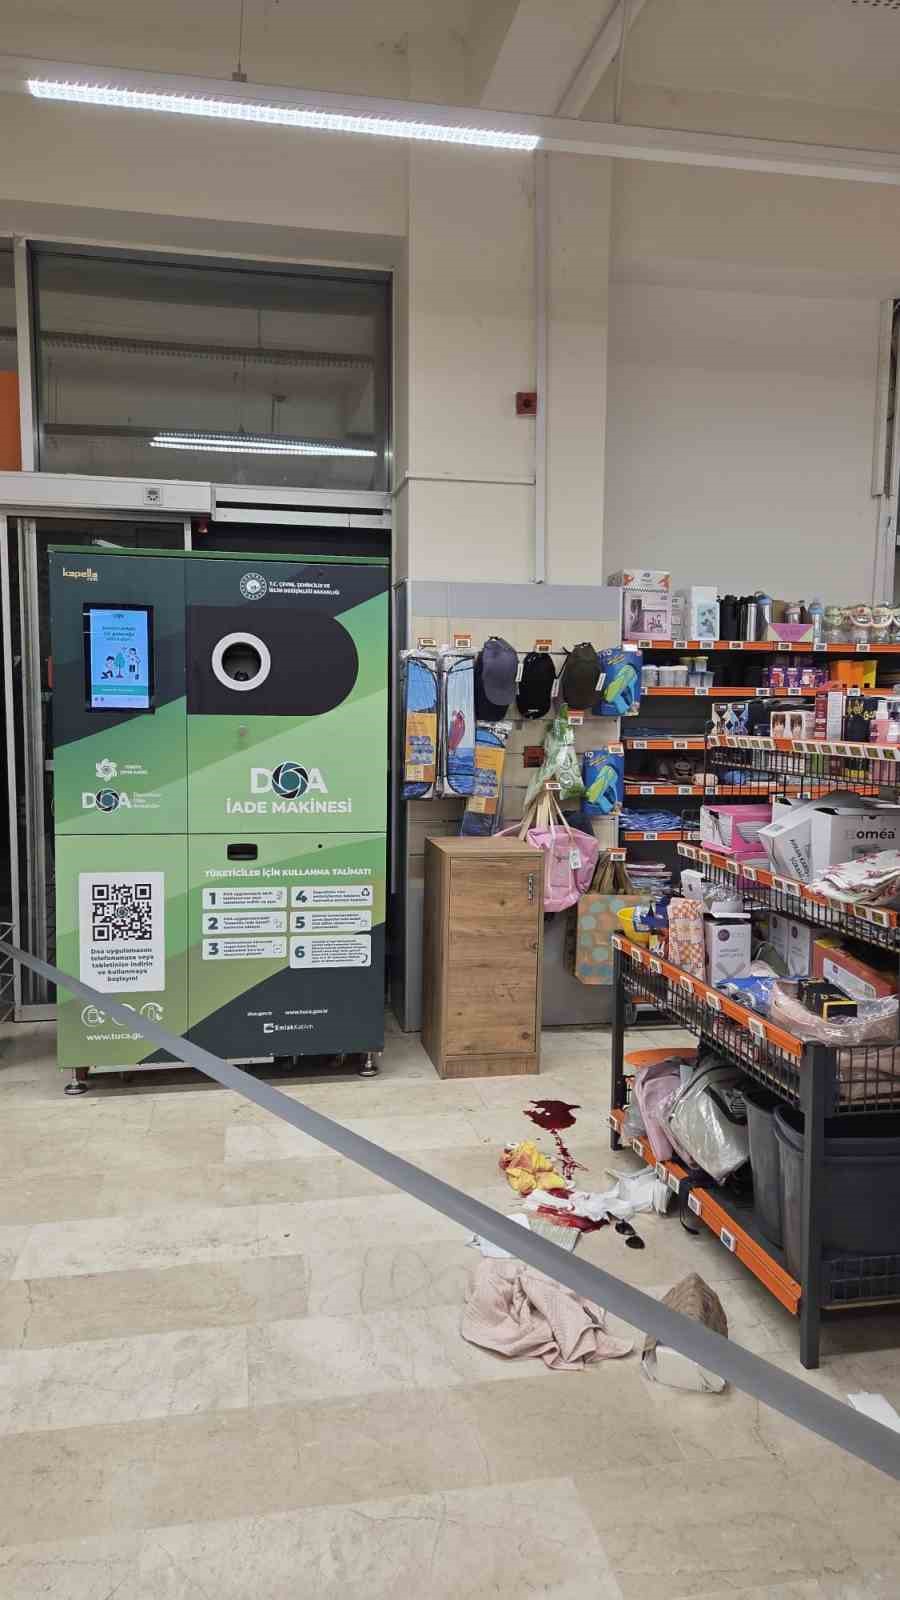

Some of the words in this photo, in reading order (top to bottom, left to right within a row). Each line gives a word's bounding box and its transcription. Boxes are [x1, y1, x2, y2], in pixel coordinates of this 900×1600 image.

[226, 797, 268, 814] İADE
[271, 797, 352, 814] MAKİNESİ
[208, 892, 216, 905] 1
[295, 890, 308, 903] 4
[207, 917, 219, 930] 2
[295, 916, 306, 929] 5
[208, 942, 219, 955] 3
[294, 945, 305, 958] 6
